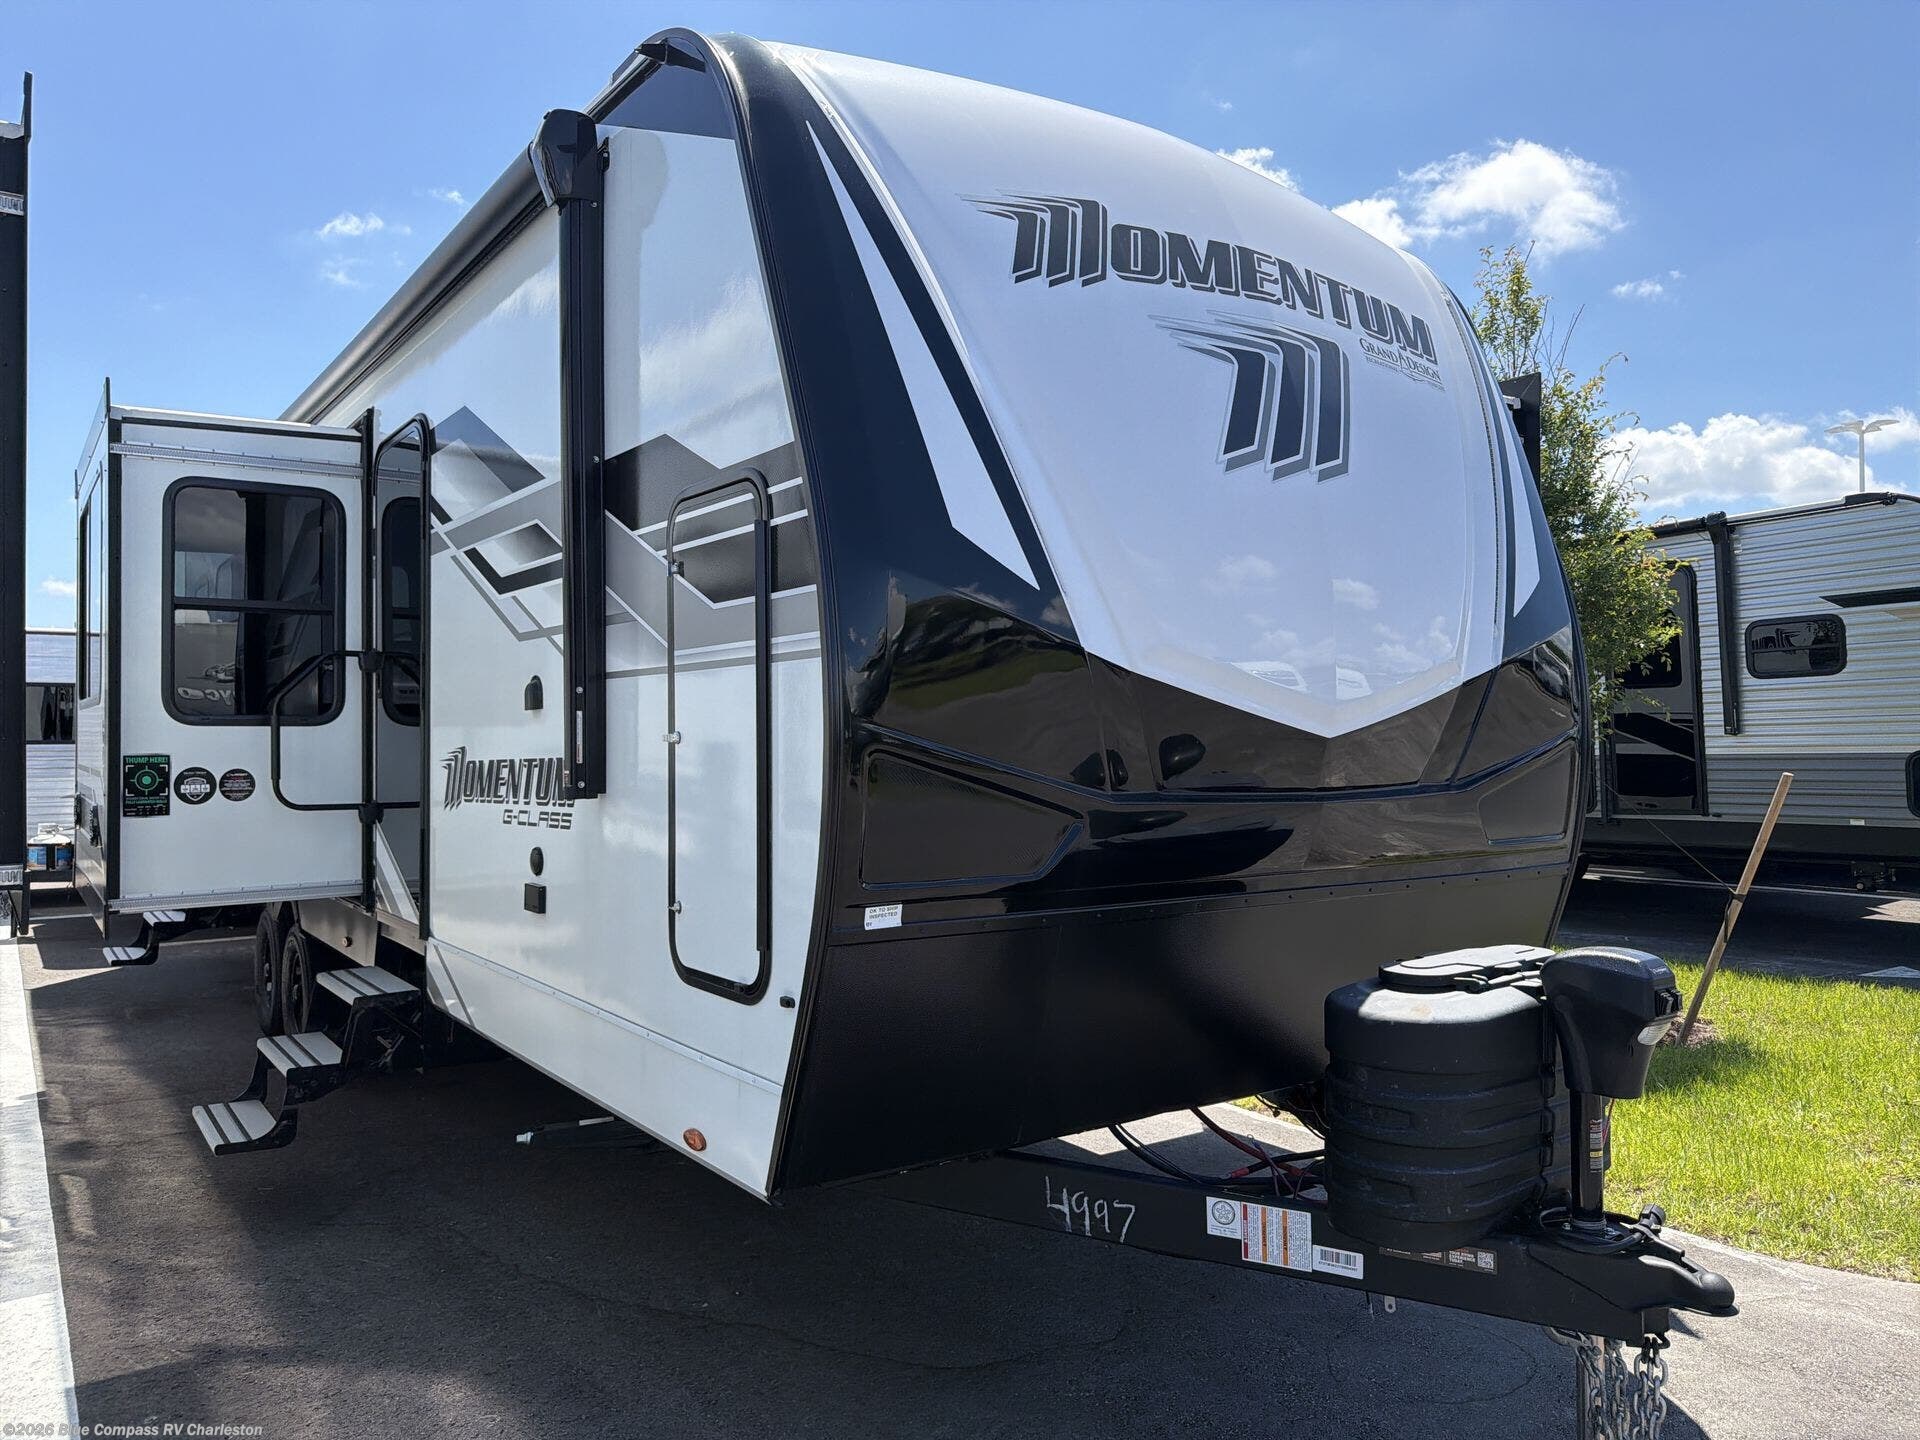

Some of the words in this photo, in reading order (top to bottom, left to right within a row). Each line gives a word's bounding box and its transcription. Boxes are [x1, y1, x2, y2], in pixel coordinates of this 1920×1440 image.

[954, 189, 1438, 366] MOMENTUM
[1360, 338, 1398, 363] GRAND
[1405, 355, 1441, 381] DESIGN
[125, 756, 149, 764] THUMP
[502, 809, 573, 830] G-CLASS
[1045, 1175, 1136, 1244] 4997
